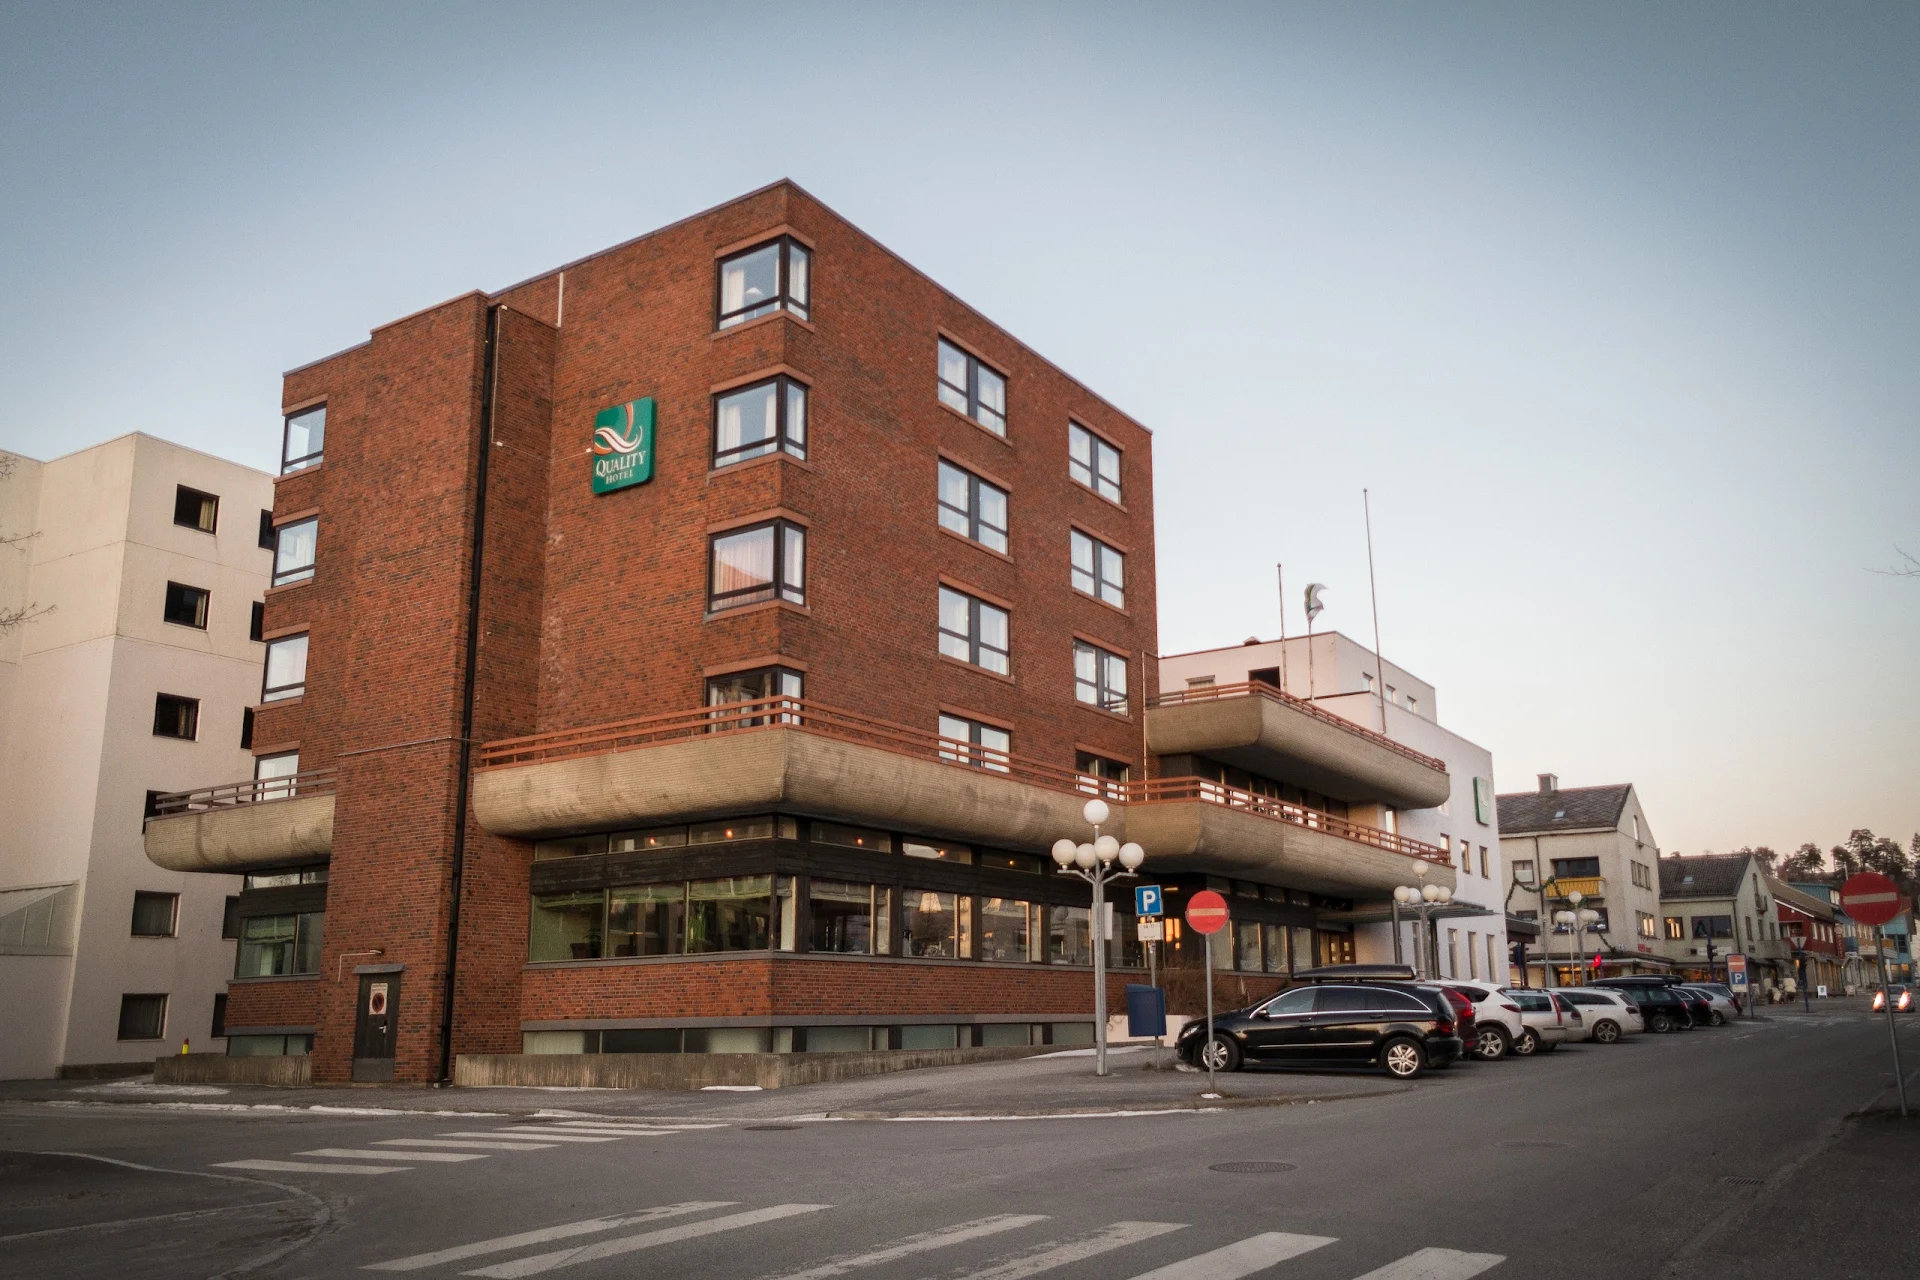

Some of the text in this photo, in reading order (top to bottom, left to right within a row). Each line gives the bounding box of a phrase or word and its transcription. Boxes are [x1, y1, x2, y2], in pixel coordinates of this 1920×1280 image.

[596, 450, 646, 477] QUALITY
[605, 470, 633, 484] HOTEL
[1143, 890, 1156, 912] P
[1734, 973, 1743, 984] P
